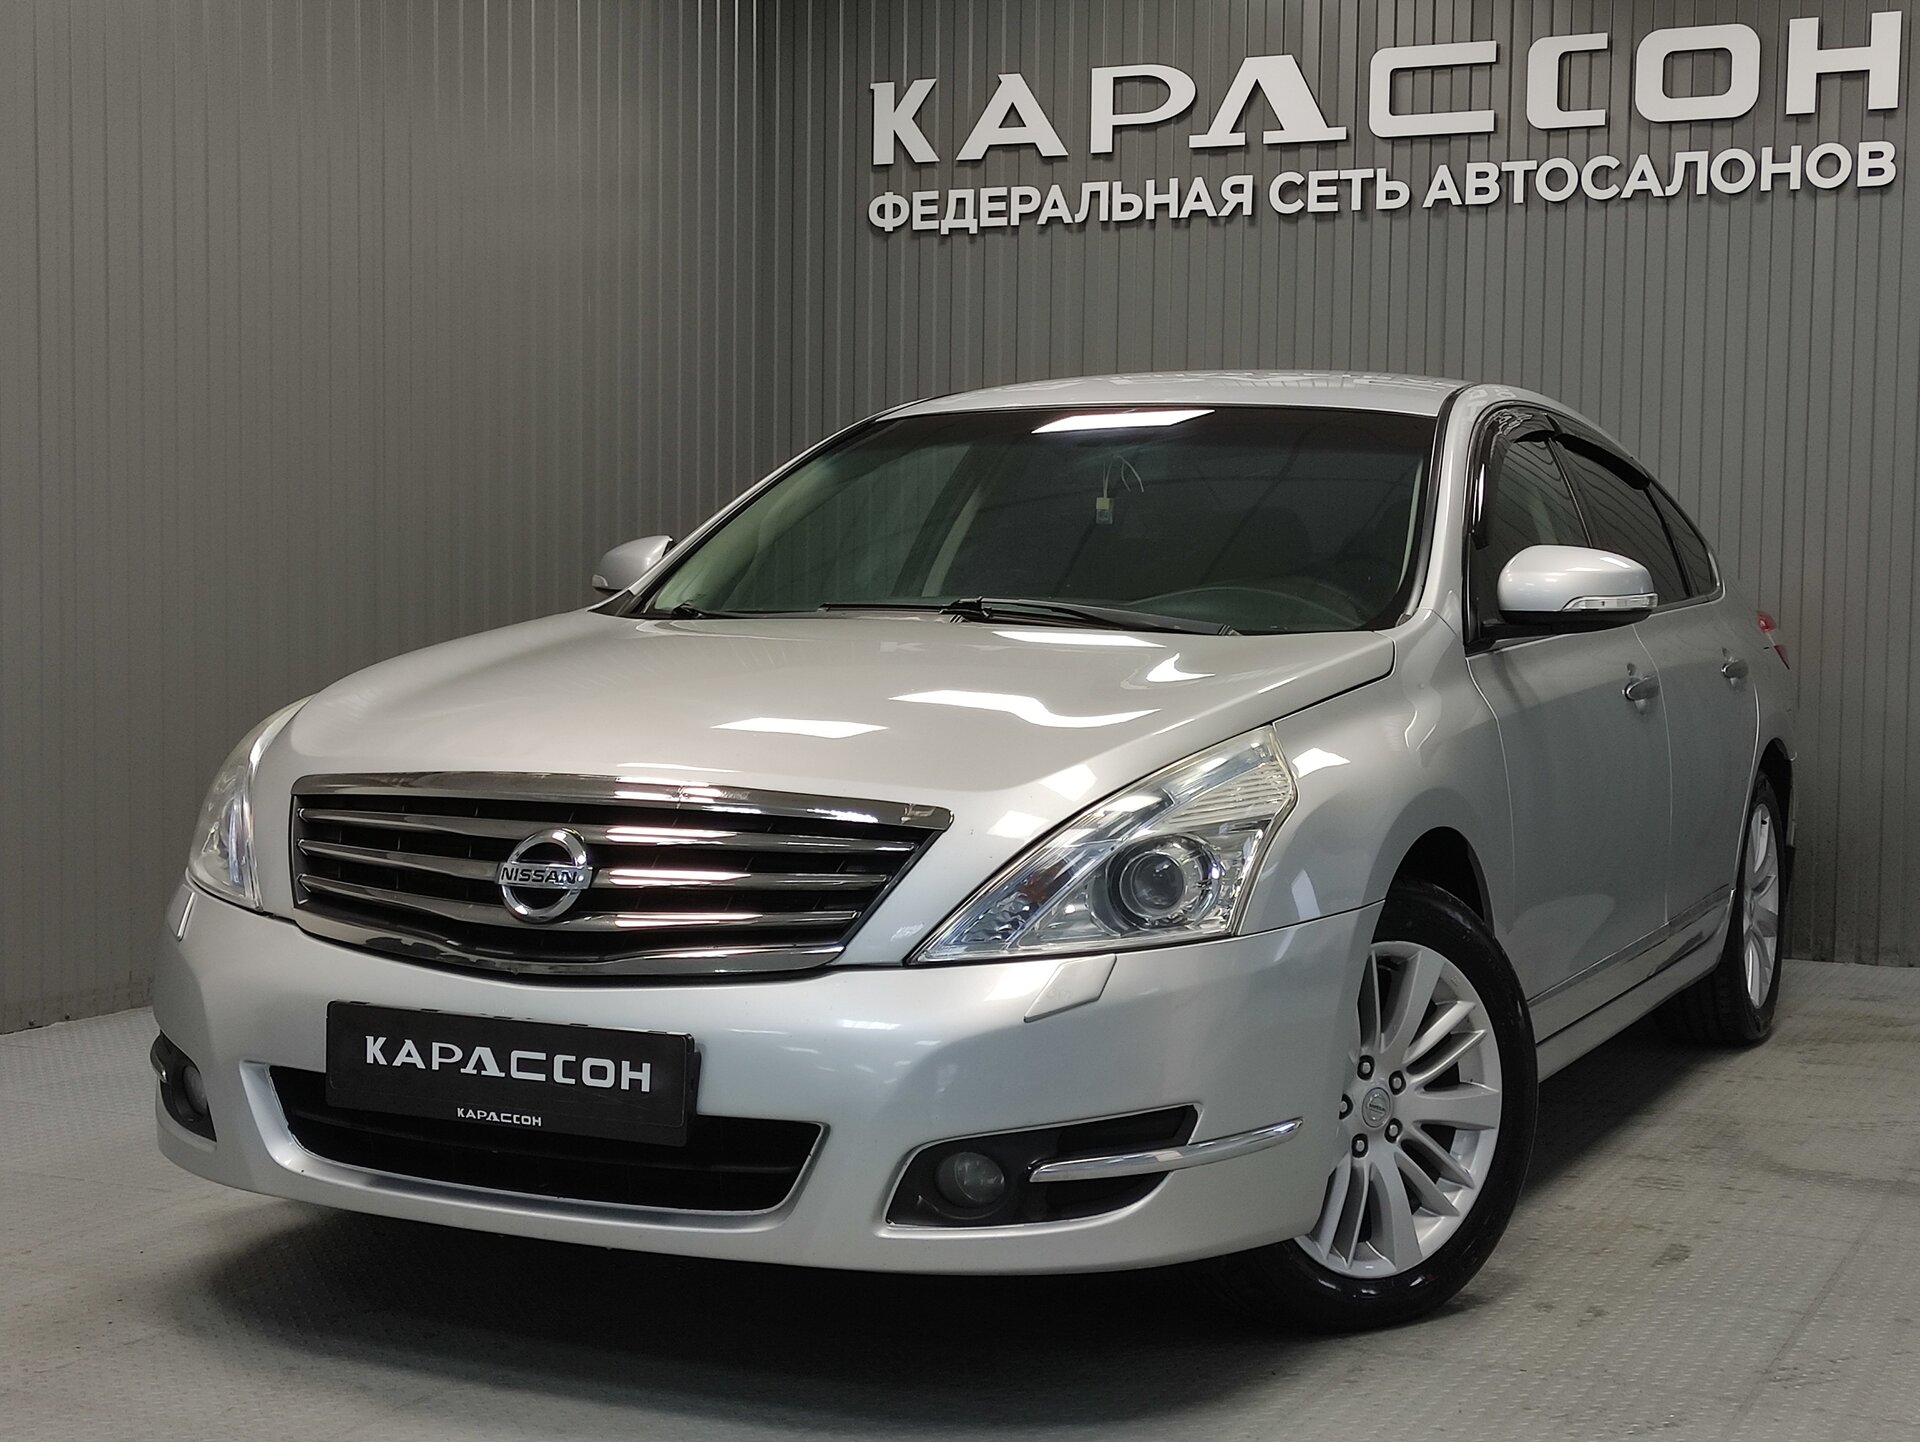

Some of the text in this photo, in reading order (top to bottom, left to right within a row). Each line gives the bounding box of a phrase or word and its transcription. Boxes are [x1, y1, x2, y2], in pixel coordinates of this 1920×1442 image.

[868, 141, 1897, 235] ФЕДЕРАЛЬНАЯ СЕТЬ АВТОСАЛОНОВ
[501, 867, 577, 884] NISSAN
